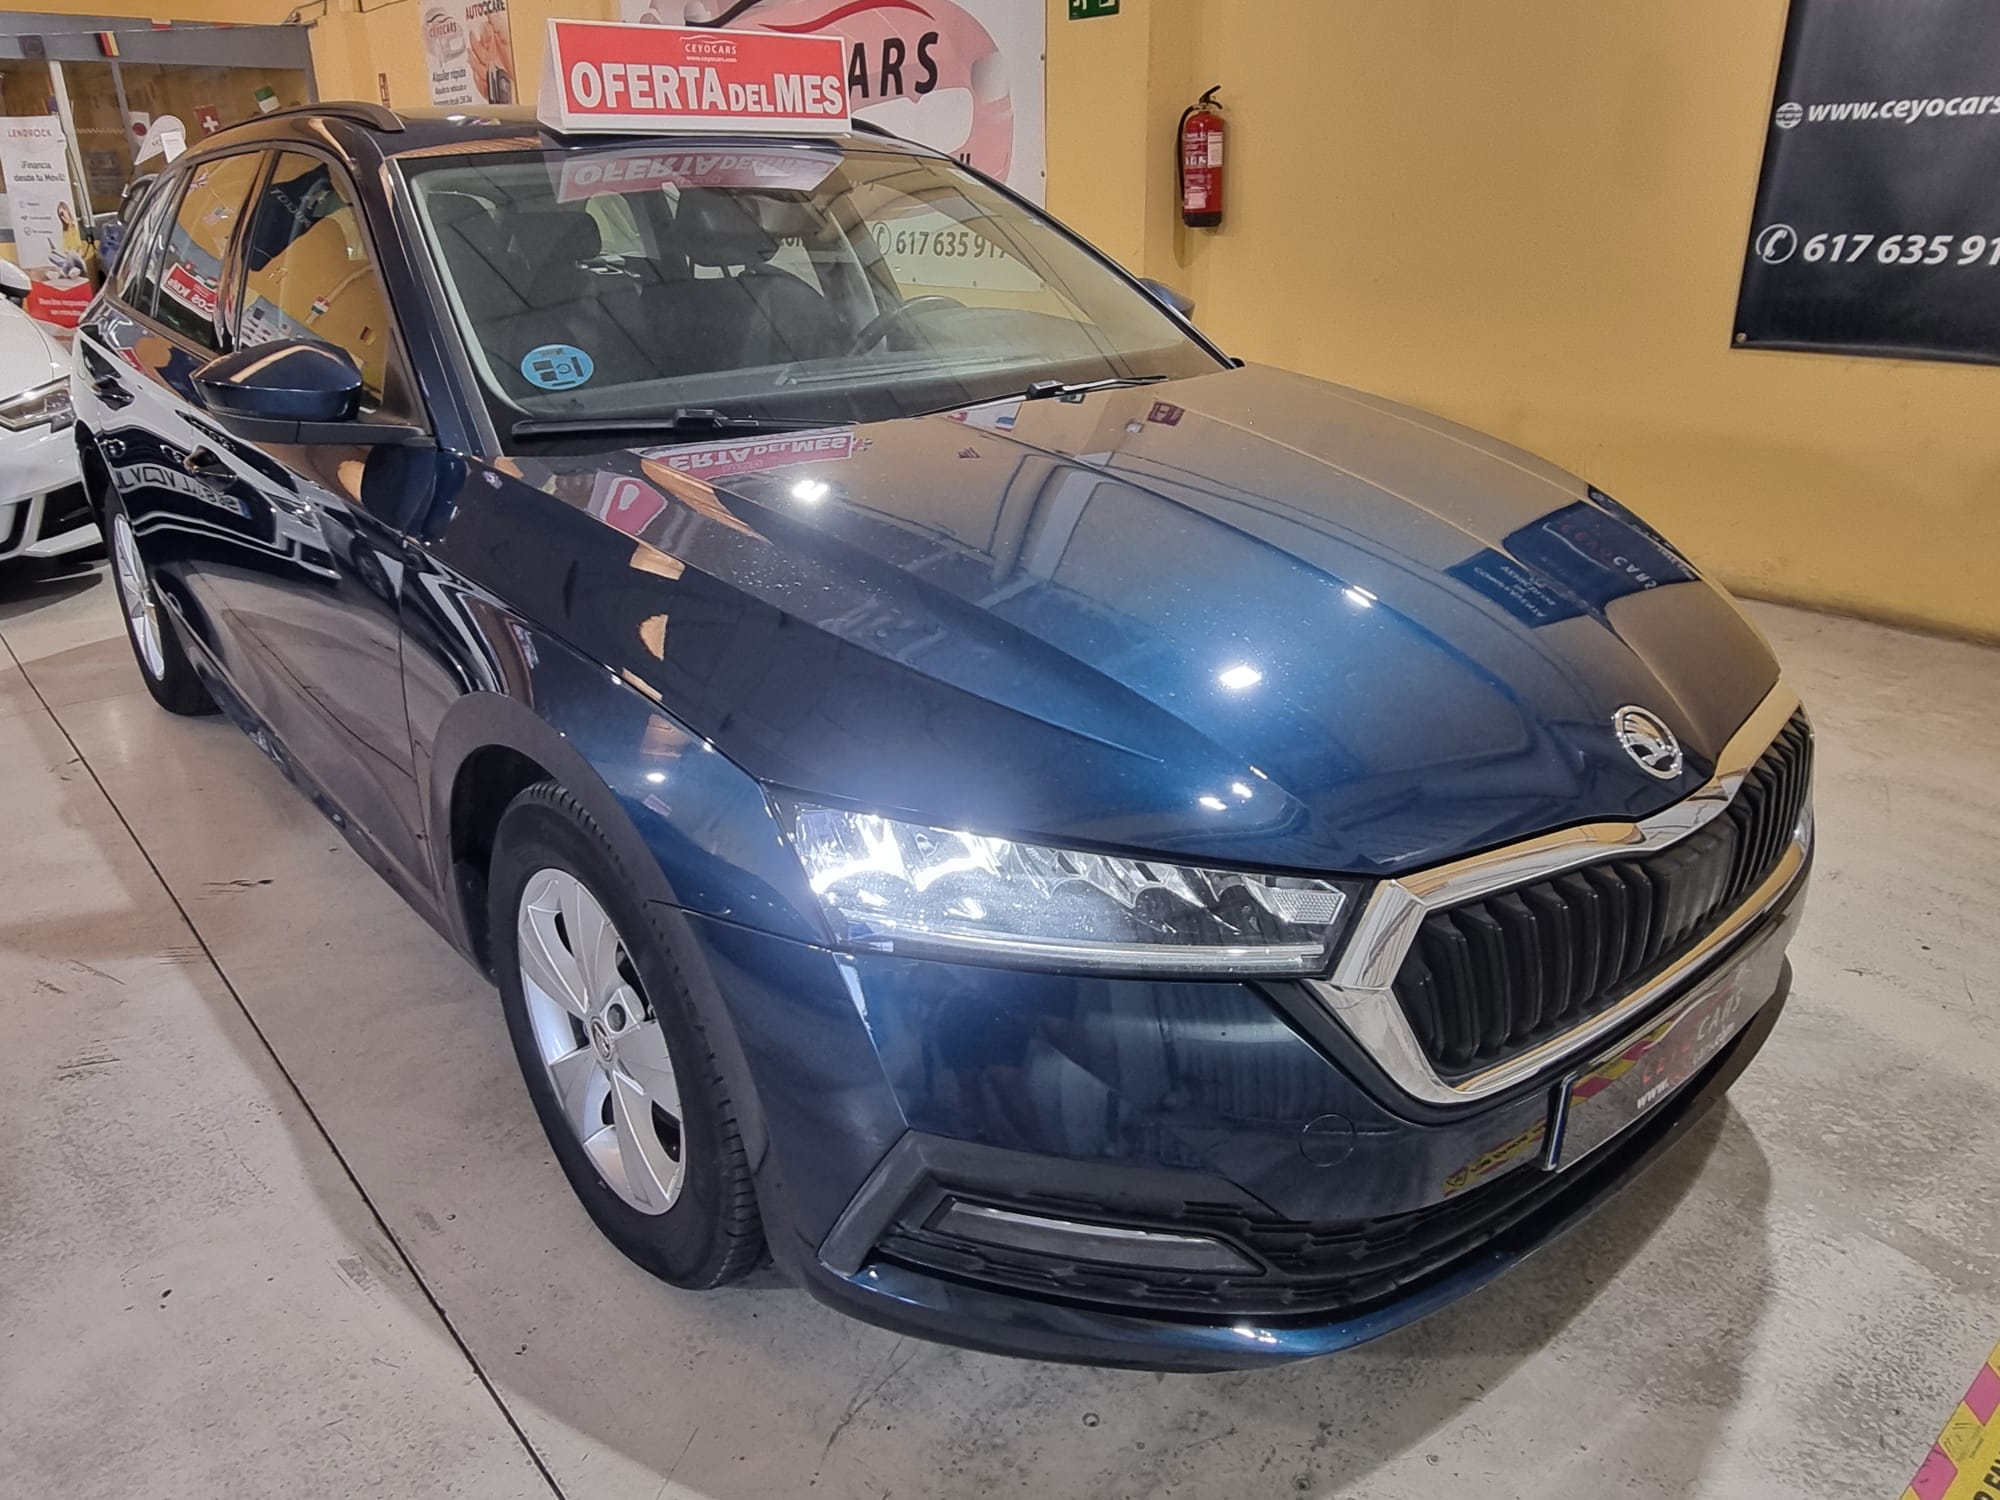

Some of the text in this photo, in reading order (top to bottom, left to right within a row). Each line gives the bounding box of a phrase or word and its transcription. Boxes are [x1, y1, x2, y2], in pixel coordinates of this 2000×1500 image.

[685, 43, 737, 55] CEYOCARS
[571, 62, 843, 115] OFERTA DEL MES
[1808, 95, 2000, 124] www.ceyocars
[8, 128, 51, 138] LENDROCK
[896, 231, 929, 255] 617
[933, 231, 969, 257] 635
[1803, 234, 2000, 265] 617 635 91
